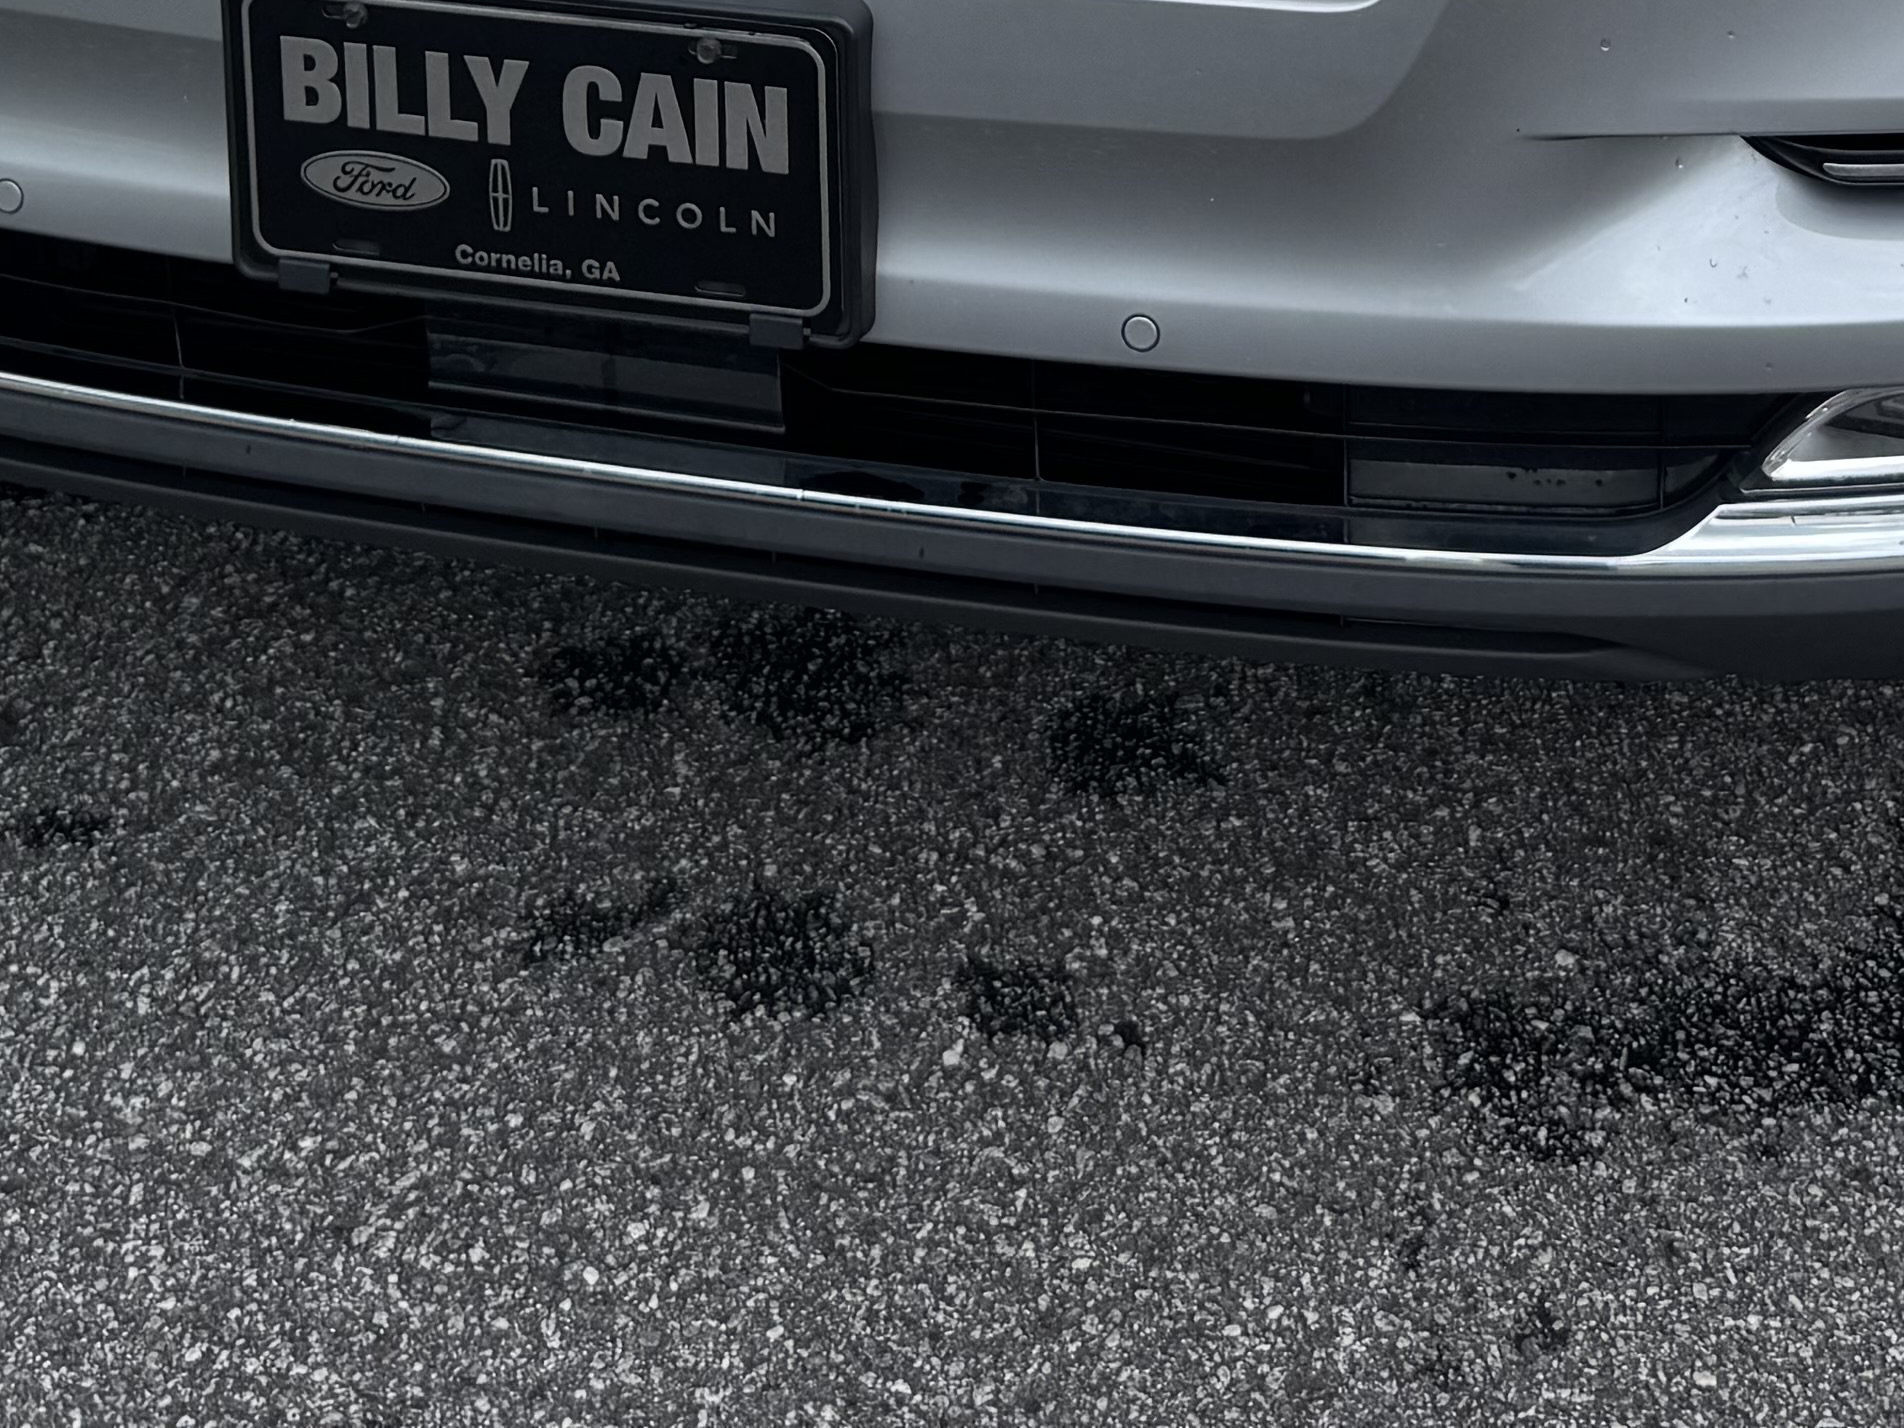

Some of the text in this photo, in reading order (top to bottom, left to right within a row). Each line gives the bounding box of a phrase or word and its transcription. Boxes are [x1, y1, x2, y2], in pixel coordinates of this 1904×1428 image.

[279, 34, 789, 175] BILLY CAIN
[333, 160, 776, 238] Ford LINCOLN
[455, 243, 621, 282] Cornelia, GA
